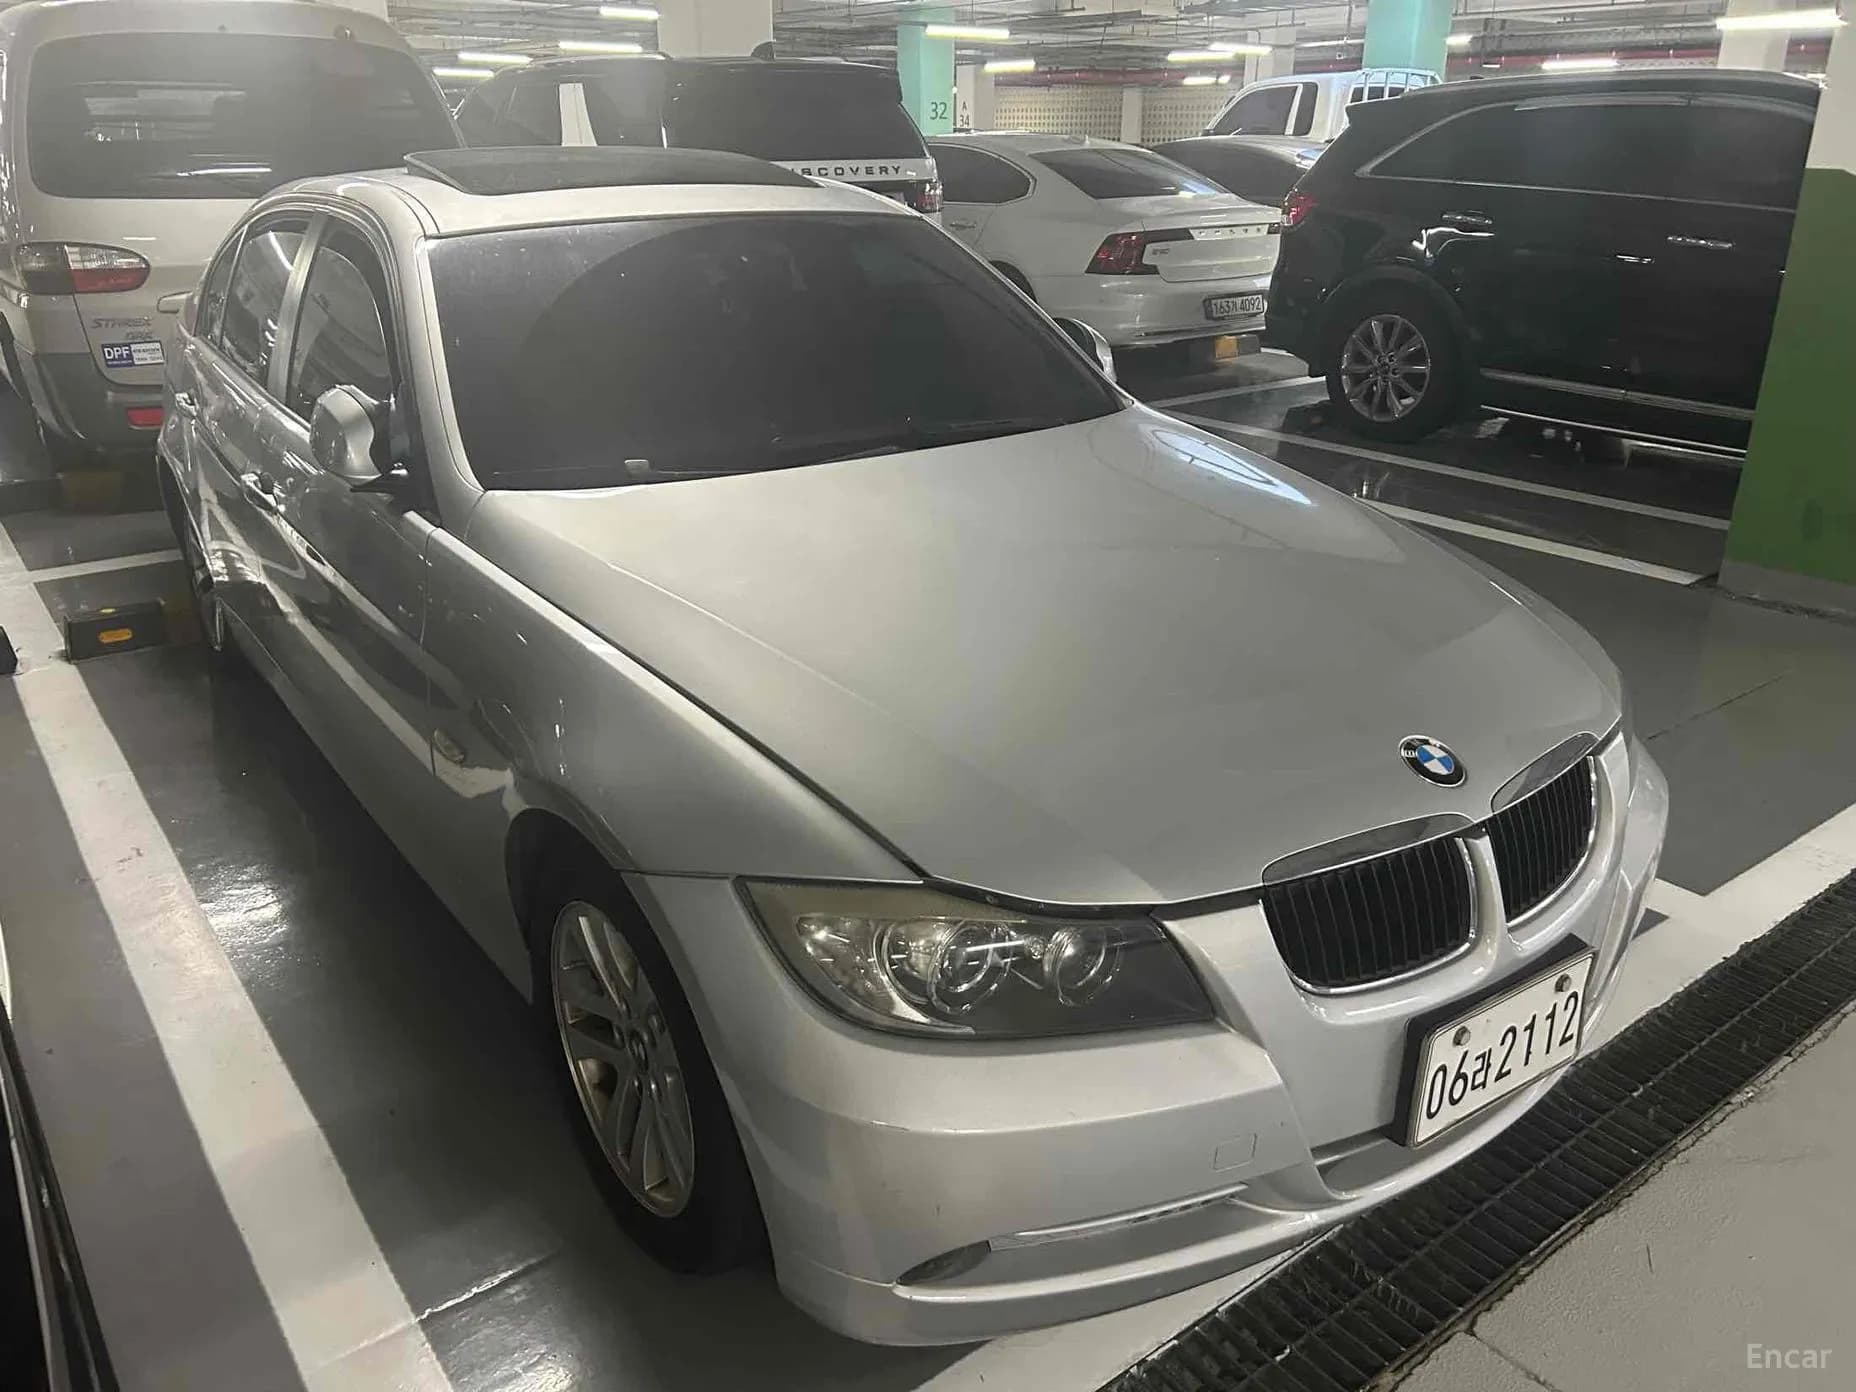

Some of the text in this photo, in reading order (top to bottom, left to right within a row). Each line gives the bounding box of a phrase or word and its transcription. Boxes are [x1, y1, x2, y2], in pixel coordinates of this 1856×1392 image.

[930, 101, 948, 120] 32
[962, 101, 968, 111] A
[960, 114, 970, 127] 34
[790, 165, 901, 177] SCOVERY
[103, 346, 131, 360] DPF
[1426, 990, 1579, 1120] 06라2112
